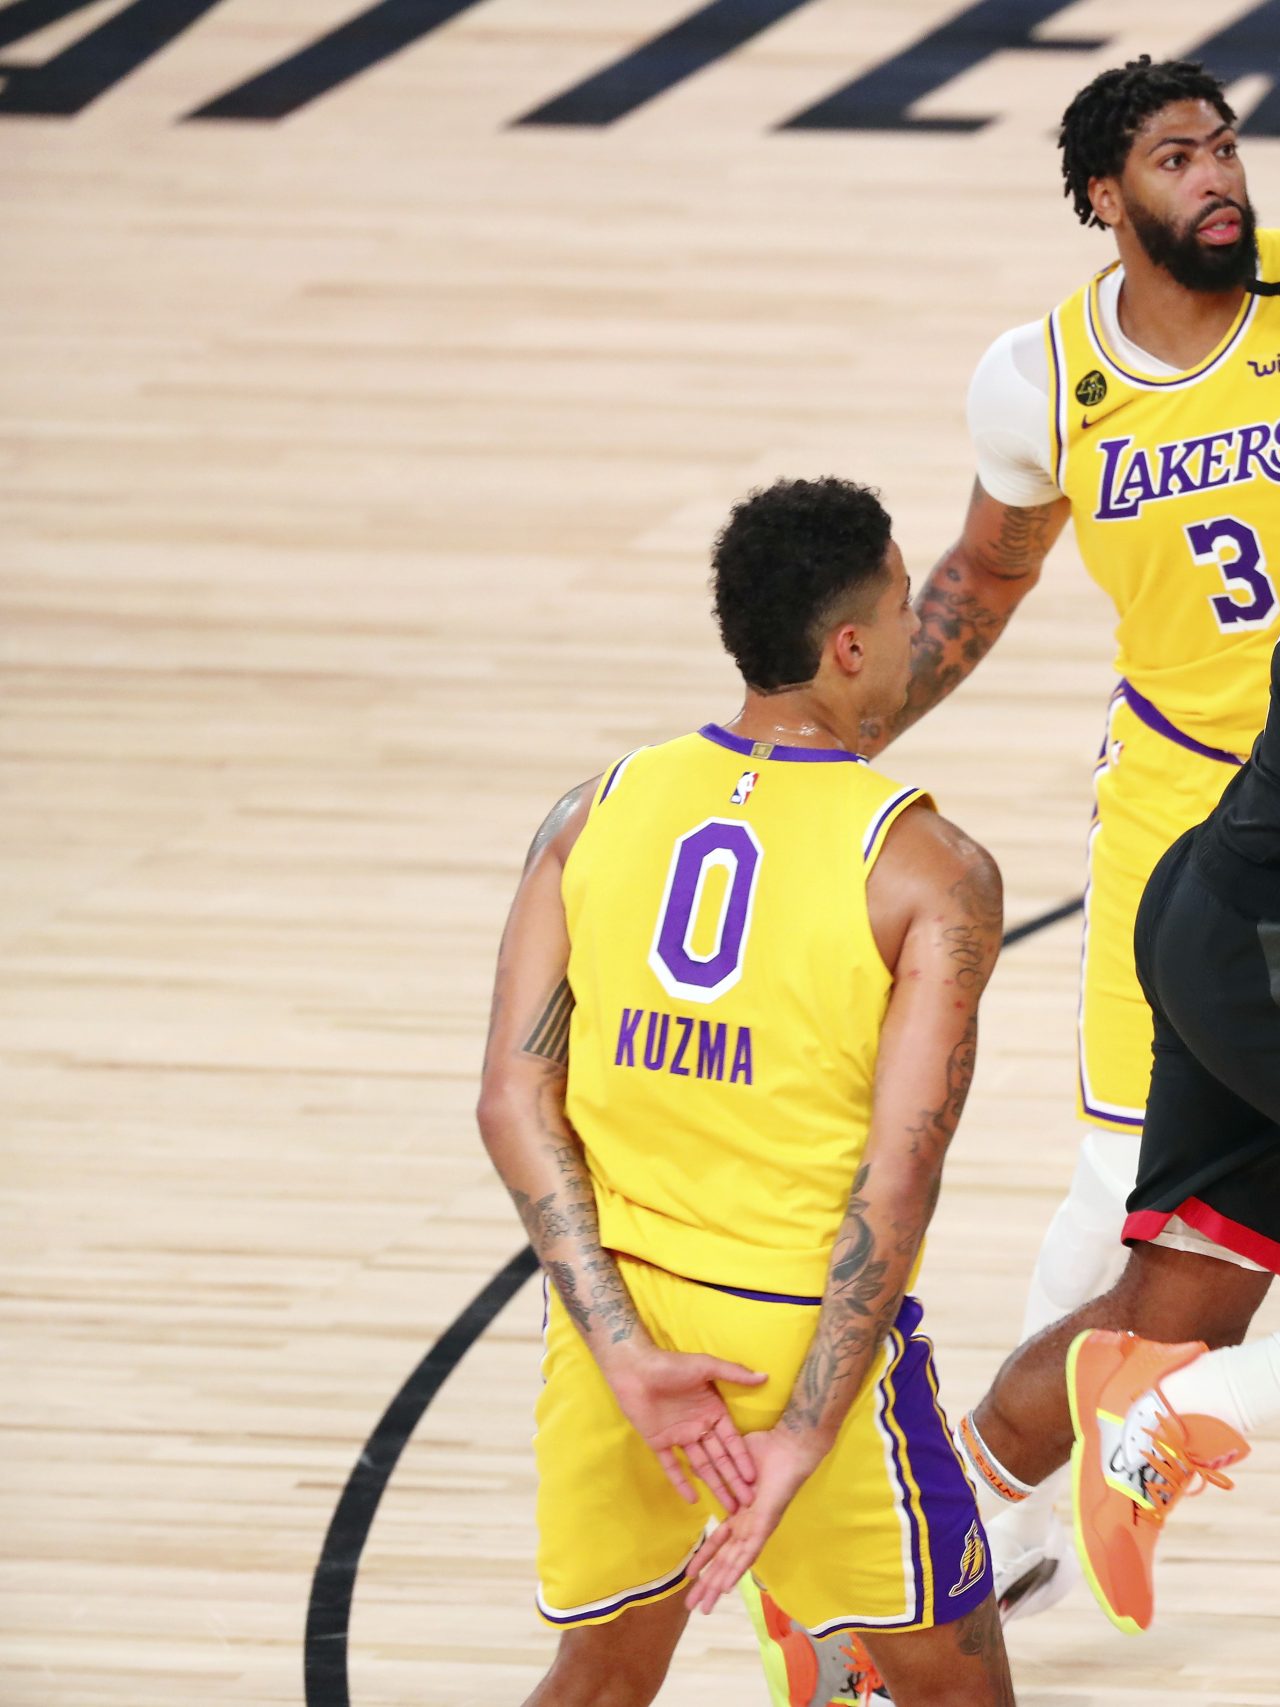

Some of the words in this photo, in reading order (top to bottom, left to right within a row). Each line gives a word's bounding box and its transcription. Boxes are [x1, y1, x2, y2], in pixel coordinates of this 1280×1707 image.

[1182, 515, 1280, 634] 3
[648, 816, 764, 1004] 0
[614, 1008, 753, 1086] KUZMA
